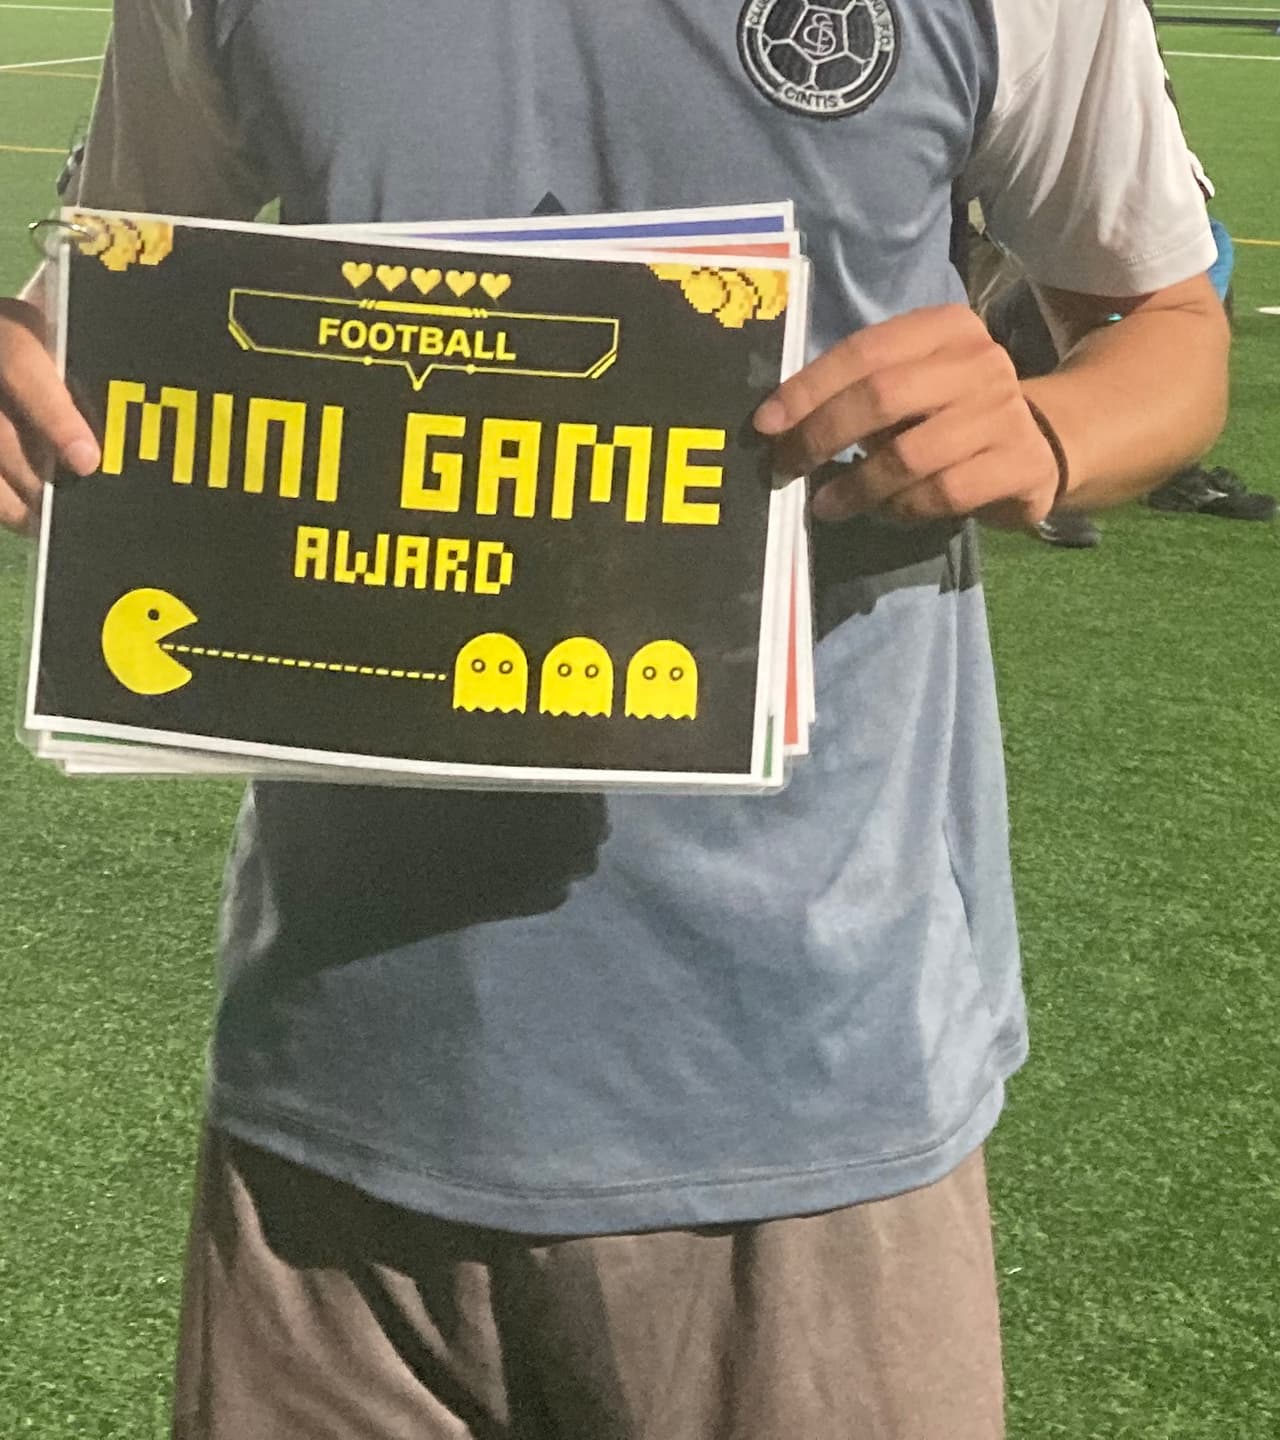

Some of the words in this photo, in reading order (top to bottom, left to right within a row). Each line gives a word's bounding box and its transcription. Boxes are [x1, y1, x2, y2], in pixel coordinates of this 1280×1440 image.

[784, 86, 838, 109] CINTIS
[318, 317, 517, 361] FOOTBALL
[101, 379, 344, 503] MINI
[400, 411, 726, 525] GAME
[293, 525, 513, 594] AWARD
